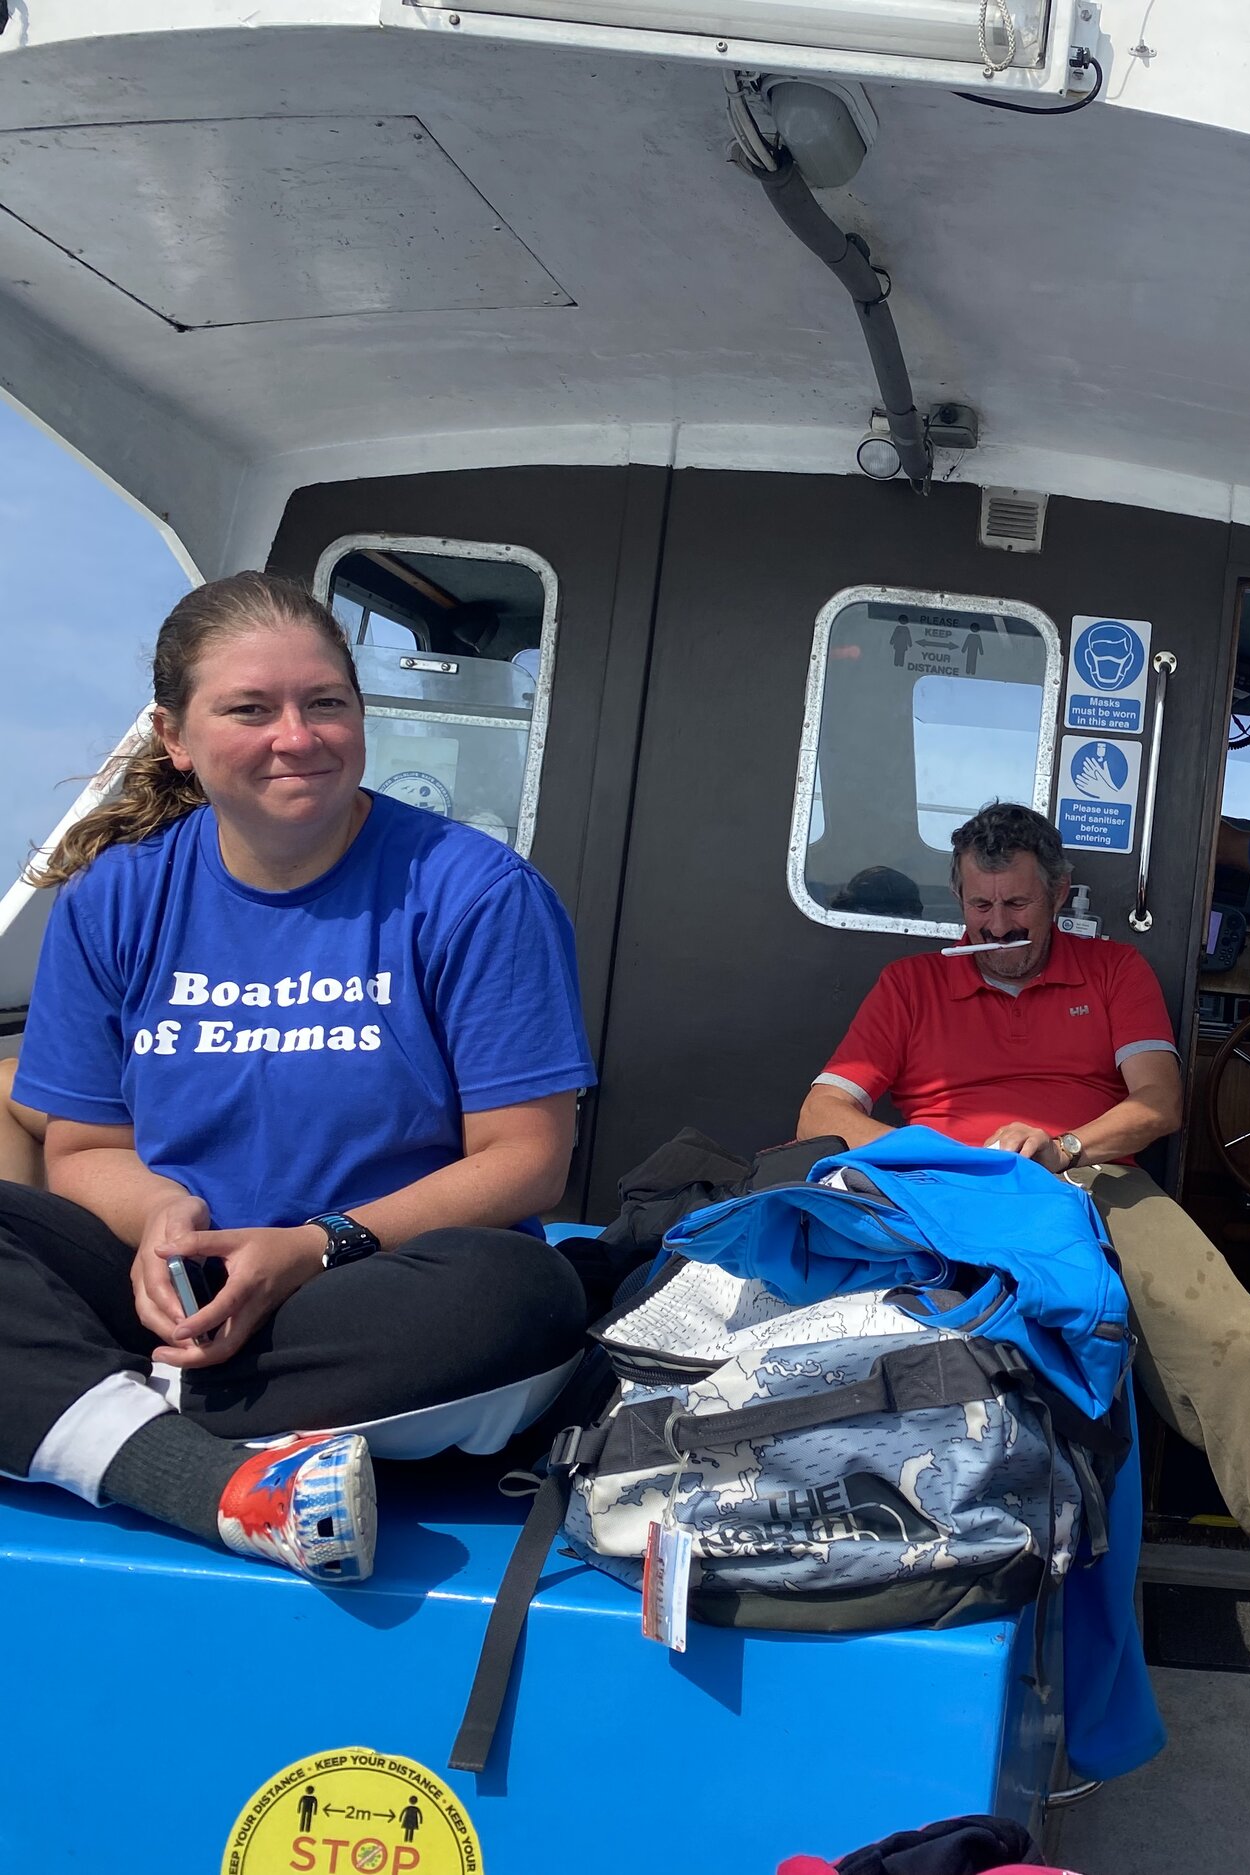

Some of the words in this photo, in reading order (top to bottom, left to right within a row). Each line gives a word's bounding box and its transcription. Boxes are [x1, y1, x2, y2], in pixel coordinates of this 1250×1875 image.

[920, 615, 959, 628] PLEASE
[924, 628, 953, 639] KEEP
[921, 652, 951, 663] YOUR
[907, 662, 960, 676] DISTANCE
[1089, 697, 1121, 708] Masks
[1071, 707, 1096, 716] must
[1098, 707, 1110, 717] be
[1112, 710, 1137, 719] worn
[1077, 717, 1086, 725] in
[1088, 717, 1107, 727] this
[1108, 720, 1130, 728] area
[1072, 803, 1102, 814] Please
[1103, 807, 1119, 815] use
[1064, 813, 1087, 822] hand
[1088, 815, 1126, 826] sanitiser
[1080, 824, 1108, 834] before
[1075, 834, 1112, 845] entering
[168, 970, 392, 1008] Boatload
[133, 1019, 182, 1056] of
[193, 1020, 382, 1053] Emmas
[761, 1481, 846, 1520] THE
[314, 1756, 348, 1771] KEEP
[350, 1755, 386, 1768] YOUR
[387, 1761, 444, 1800] DISTANCE
[252, 1768, 306, 1815] DISTANCE
[344, 1806, 372, 1821] 2m
[445, 1804, 467, 1835] KEEP
[233, 1814, 257, 1848] YOUR
[289, 1836, 420, 1875] STOP
[461, 1836, 476, 1873] YOUR
[229, 1850, 240, 1875] EEP
